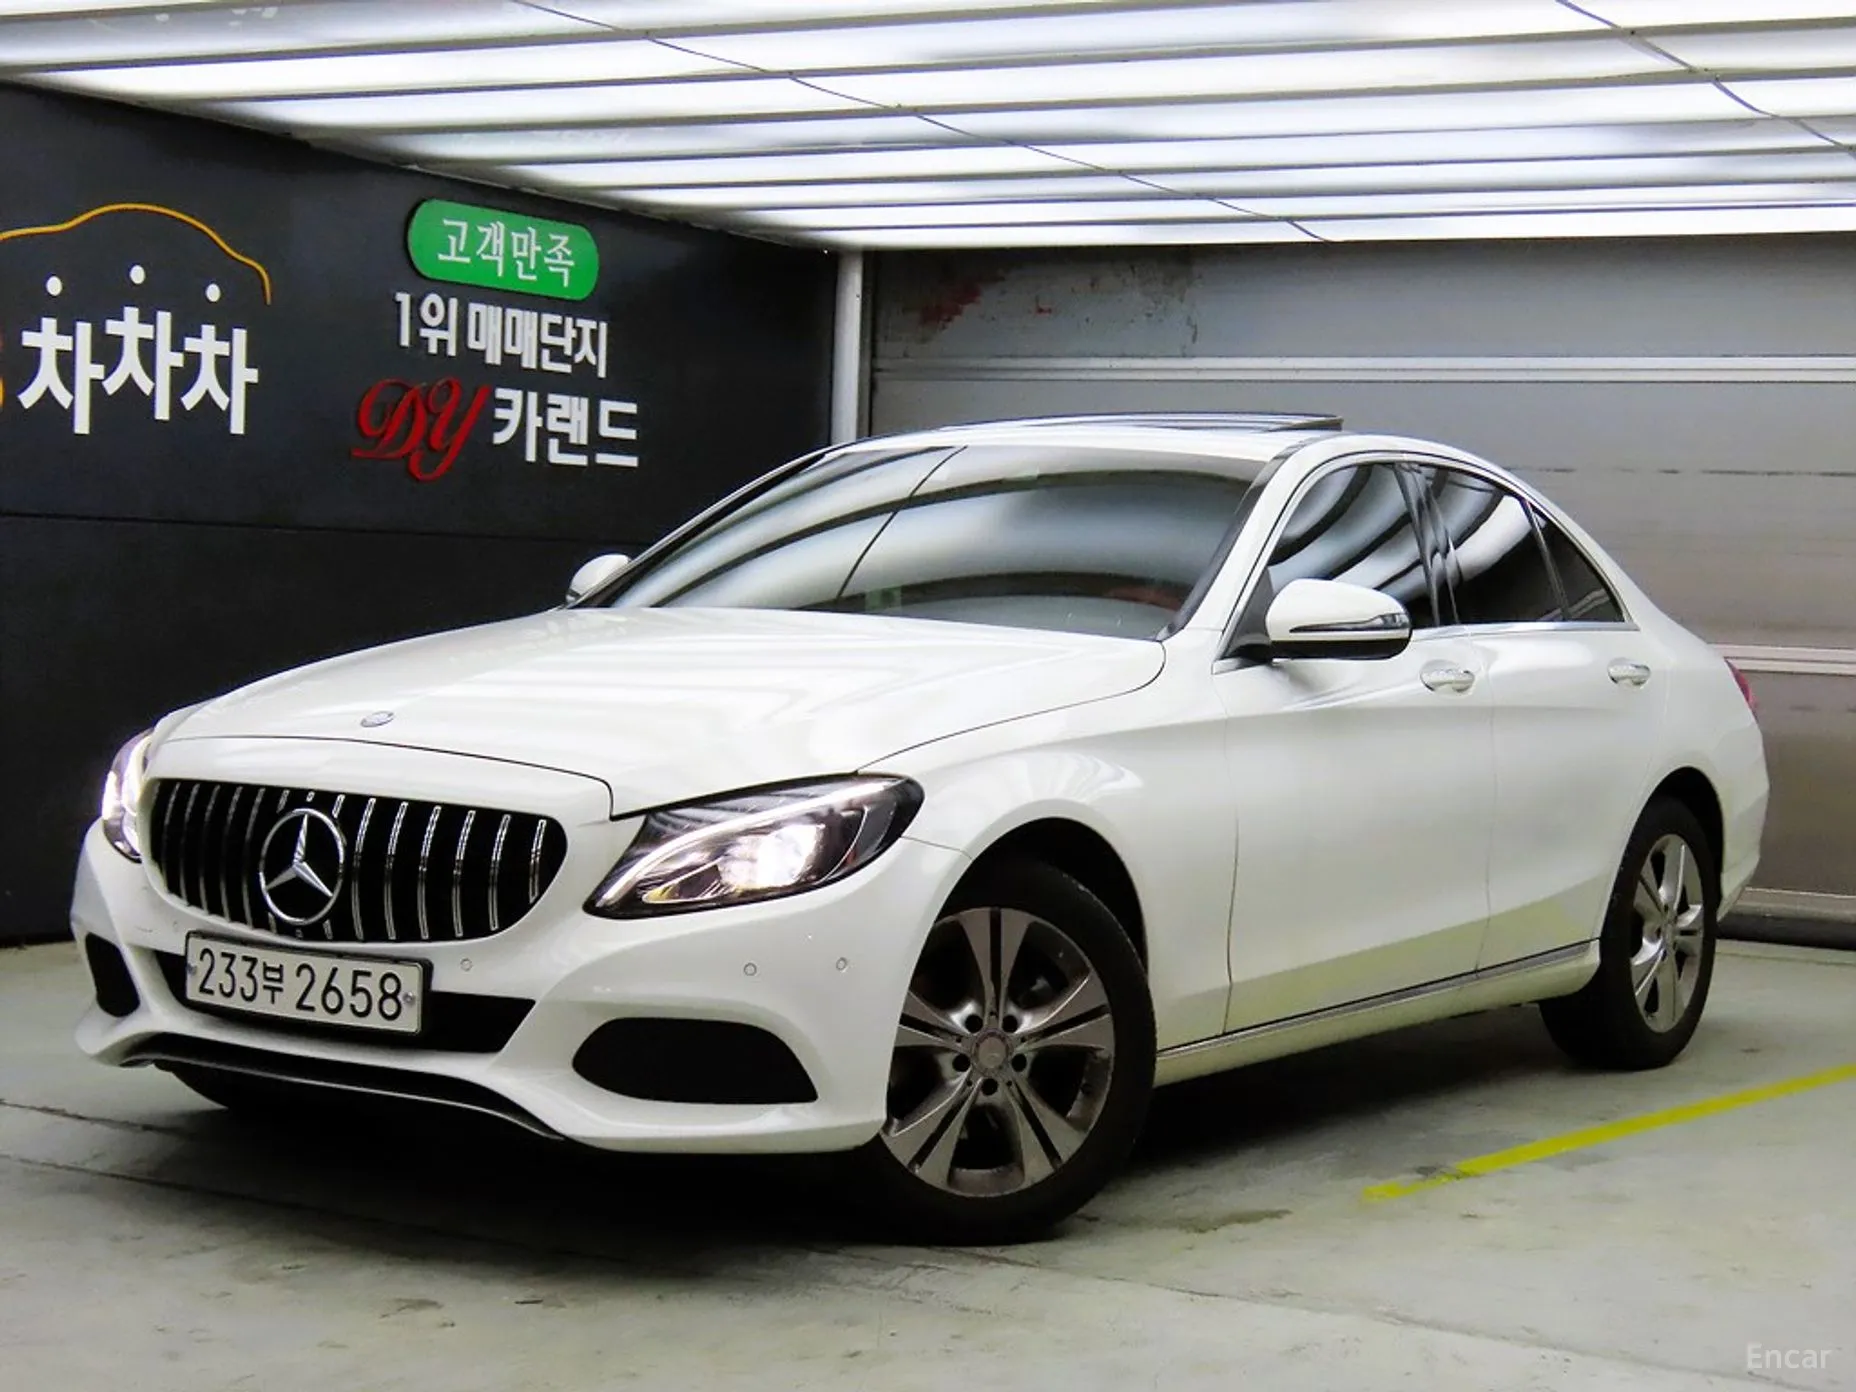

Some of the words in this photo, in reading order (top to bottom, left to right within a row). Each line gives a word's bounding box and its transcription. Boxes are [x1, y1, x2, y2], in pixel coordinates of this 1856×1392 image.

[437, 218, 576, 288] 고객만족
[17, 264, 259, 435] 차차차
[395, 292, 458, 356] 1위
[466, 301, 608, 378] 매매단지
[351, 376, 490, 482] DY
[492, 387, 639, 467] 카랜드
[198, 947, 284, 1005] 233부
[295, 962, 402, 1021] 2658
